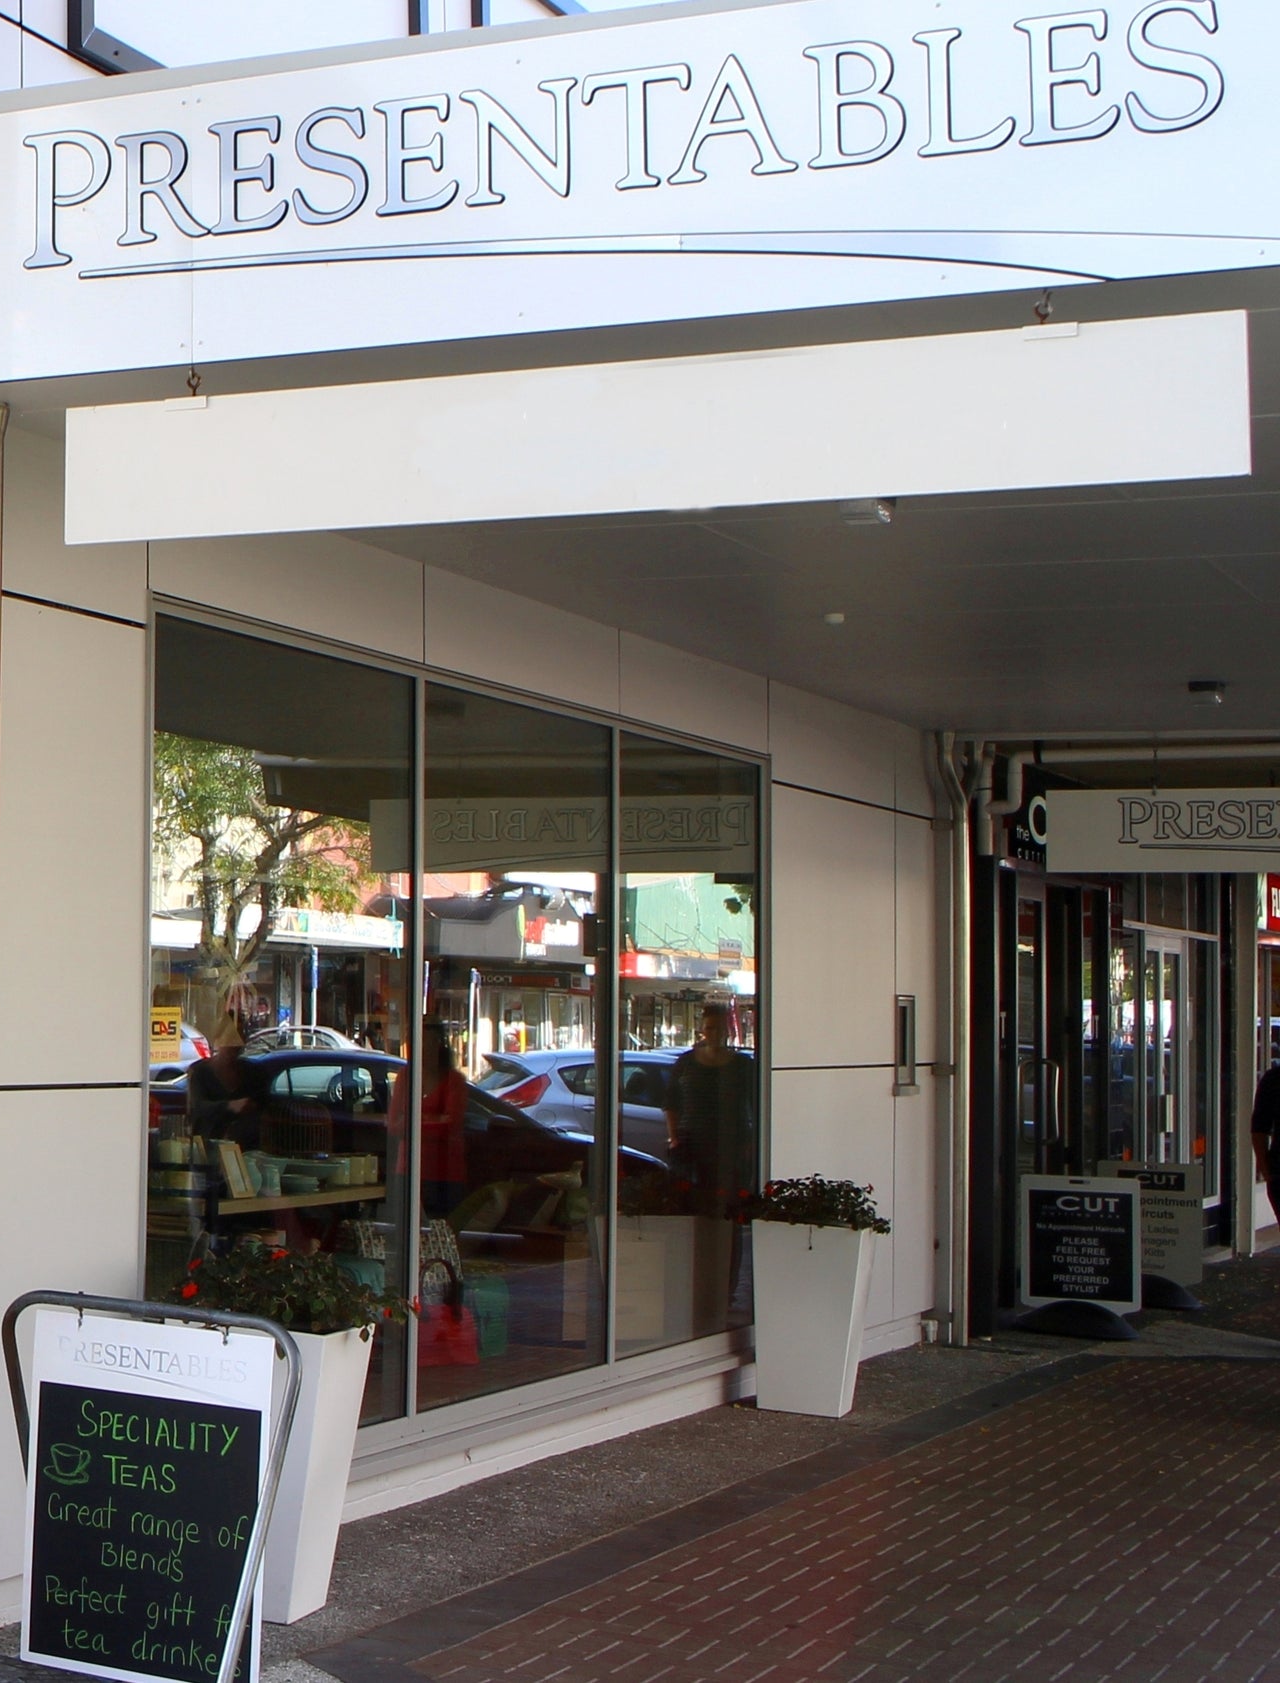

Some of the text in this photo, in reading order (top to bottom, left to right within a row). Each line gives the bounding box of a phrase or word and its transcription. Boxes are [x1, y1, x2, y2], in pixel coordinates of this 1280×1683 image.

[23, 0, 1224, 269] PRESENTABLES
[1117, 797, 1280, 844] PRESE
[1135, 1173, 1178, 1186] CUT
[1055, 1195, 1120, 1213] CUT
[1140, 1196, 1198, 1208] pointment
[1141, 1208, 1175, 1220] ircuts
[1062, 1236, 1100, 1246] PLEASE
[1055, 1245, 1106, 1256] FEEL FREE
[1051, 1254, 1111, 1266] TO REQUEST
[1067, 1265, 1095, 1274] YOUR
[1052, 1274, 1110, 1285] PREFERRED
[1062, 1284, 1100, 1294] STYLIST
[57, 1335, 248, 1384] PRESENTABLES
[77, 1399, 239, 1456] SPECIALITY
[102, 1454, 176, 1494] TEAS
[47, 1492, 249, 1557] Great range of
[100, 1542, 184, 1583] Blends
[45, 1575, 127, 1614] Perfect
[146, 1592, 196, 1630] gift
[61, 1618, 111, 1655] tea
